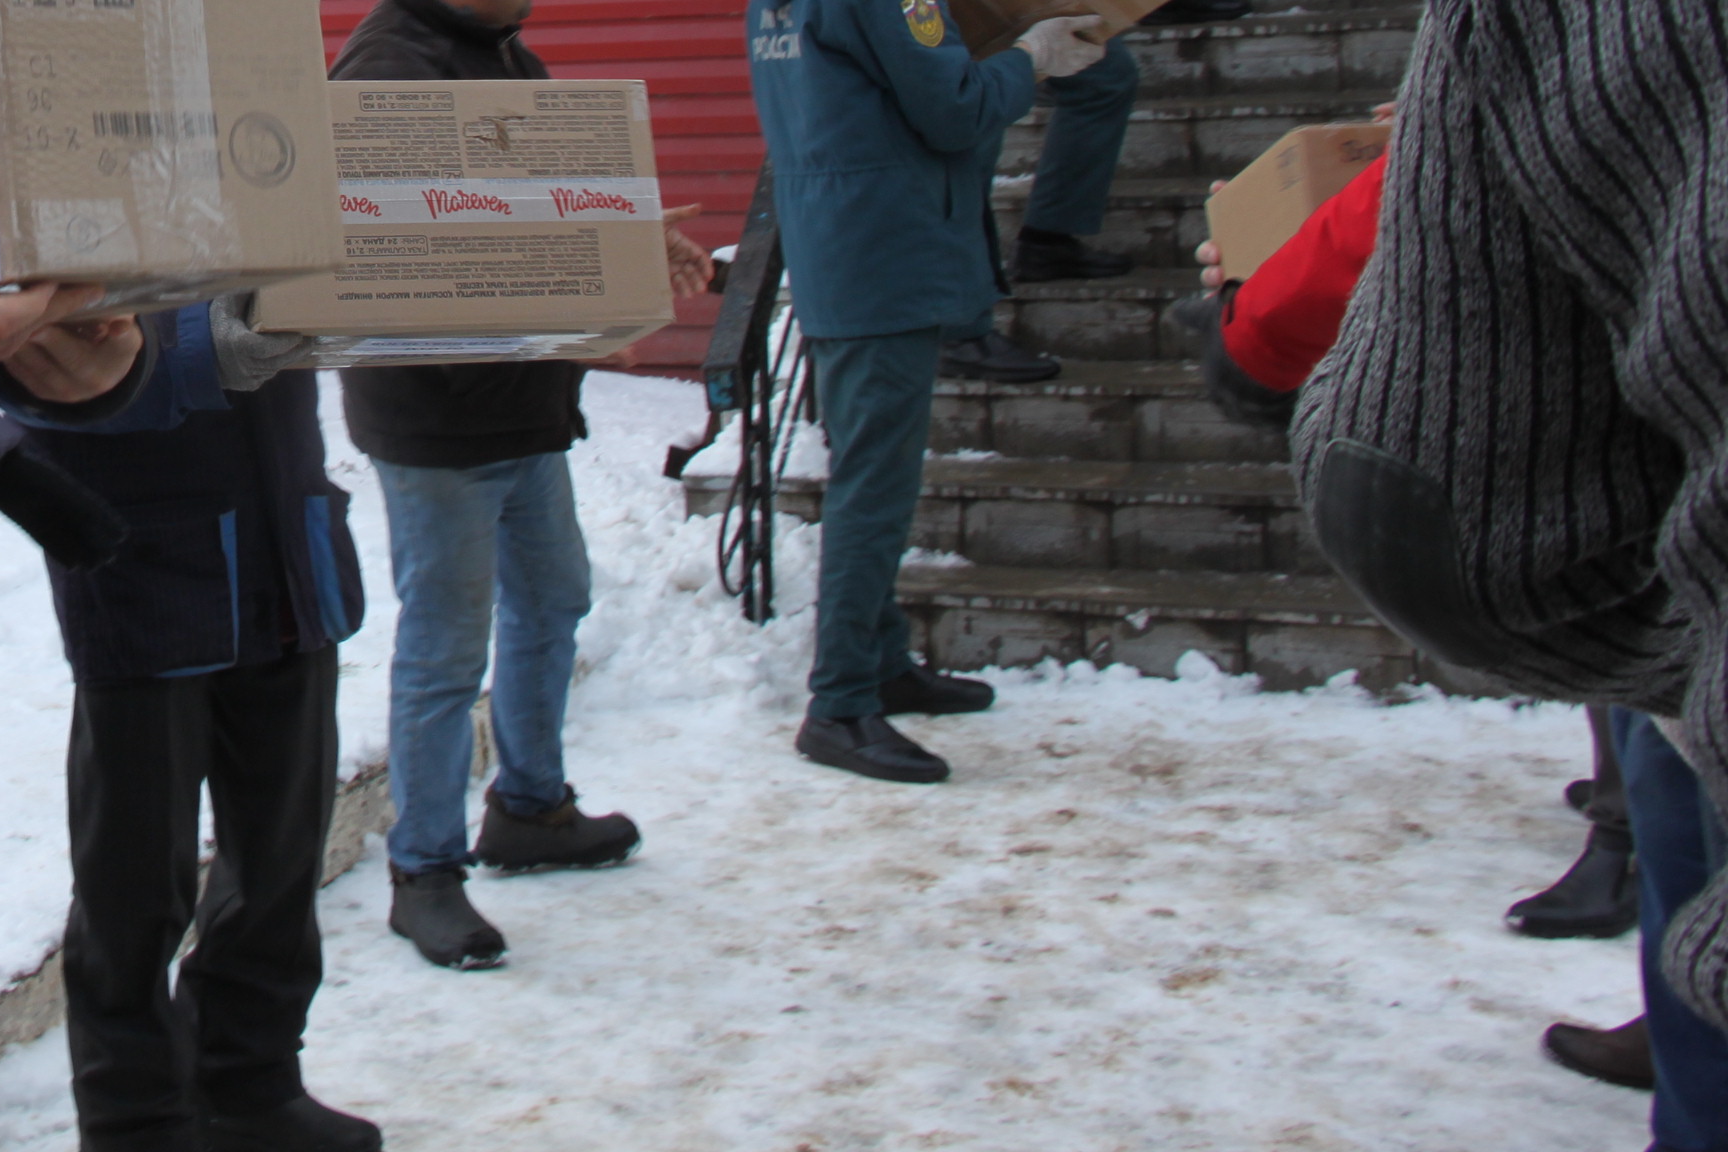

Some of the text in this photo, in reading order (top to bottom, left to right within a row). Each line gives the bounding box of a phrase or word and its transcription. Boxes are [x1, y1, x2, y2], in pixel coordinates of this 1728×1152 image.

[340, 193, 382, 217] even
[422, 188, 512, 219] Mareven
[549, 187, 636, 218] Mareven
[586, 282, 602, 293] KZ
